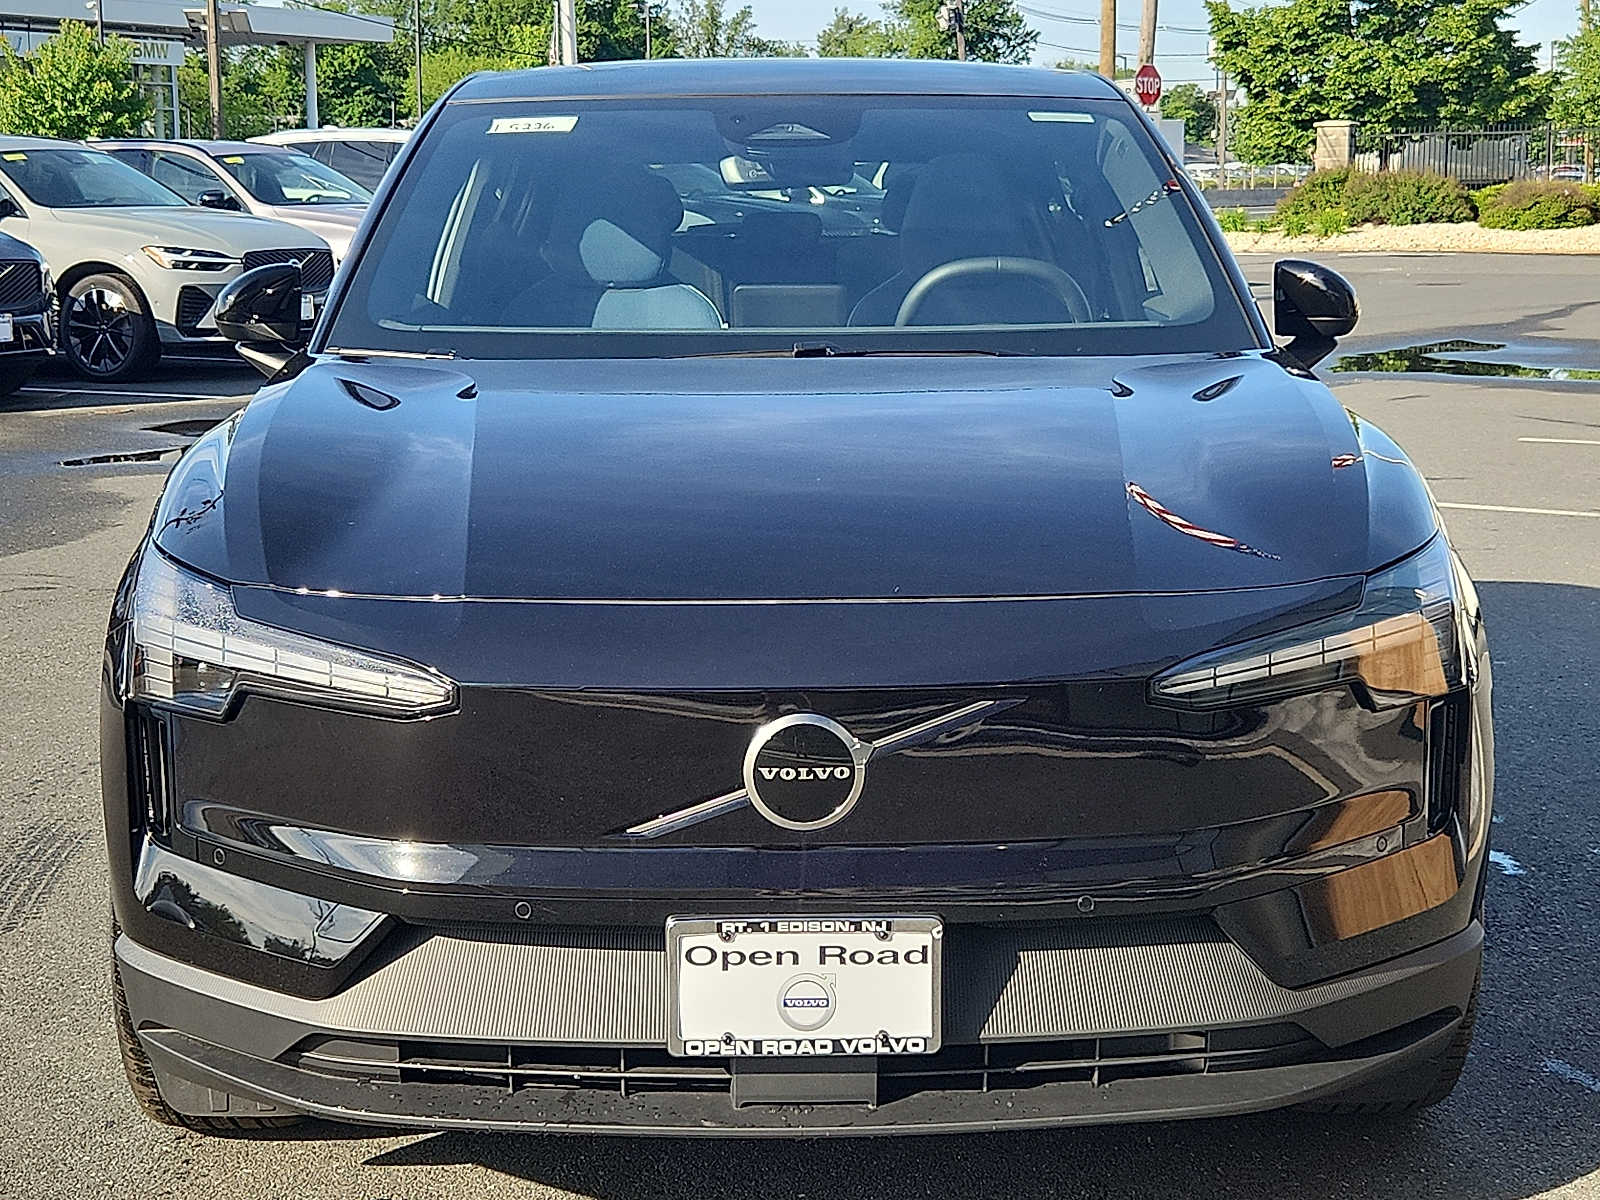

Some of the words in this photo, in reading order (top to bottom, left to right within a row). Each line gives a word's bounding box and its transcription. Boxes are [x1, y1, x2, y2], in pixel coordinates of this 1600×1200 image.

[132, 42, 169, 59] BMW
[1136, 77, 1160, 95] STOP
[758, 767, 850, 780] VOLVO
[721, 922, 752, 934] RT.
[759, 921, 770, 933] 1
[777, 921, 855, 933] EDISON,
[861, 920, 887, 932] NJ
[685, 945, 799, 971] Open
[819, 945, 928, 965] Road
[785, 999, 828, 1007] VOLVO
[685, 1040, 754, 1055] OPEN
[761, 1039, 833, 1055] ROAD
[841, 1038, 925, 1054] VOLVO
